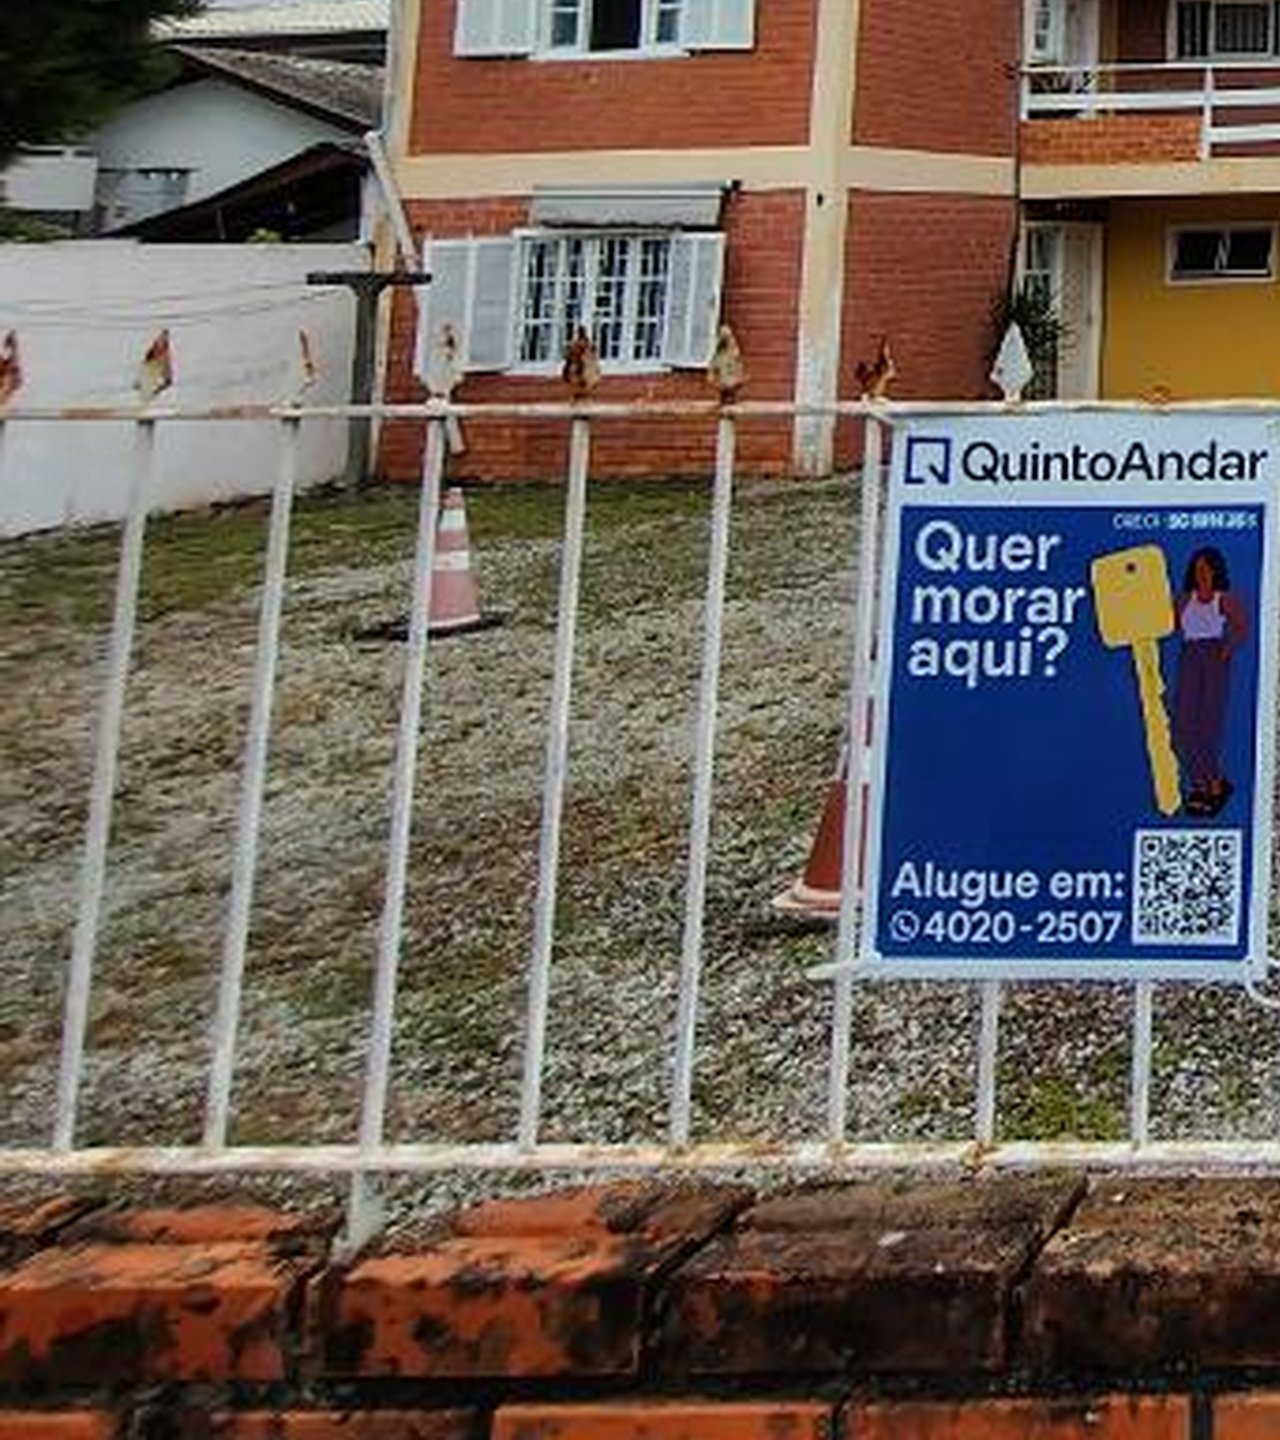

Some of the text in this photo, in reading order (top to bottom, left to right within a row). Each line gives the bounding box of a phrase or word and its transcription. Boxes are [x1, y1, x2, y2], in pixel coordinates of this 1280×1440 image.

[962, 441, 1269, 485] QuintoAndar
[915, 520, 1062, 572] Quer
[911, 585, 1086, 624] morar
[908, 626, 1069, 688] aqui?
[891, 861, 1125, 908] Alugue em:
[923, 911, 1123, 943] 4020-2507
